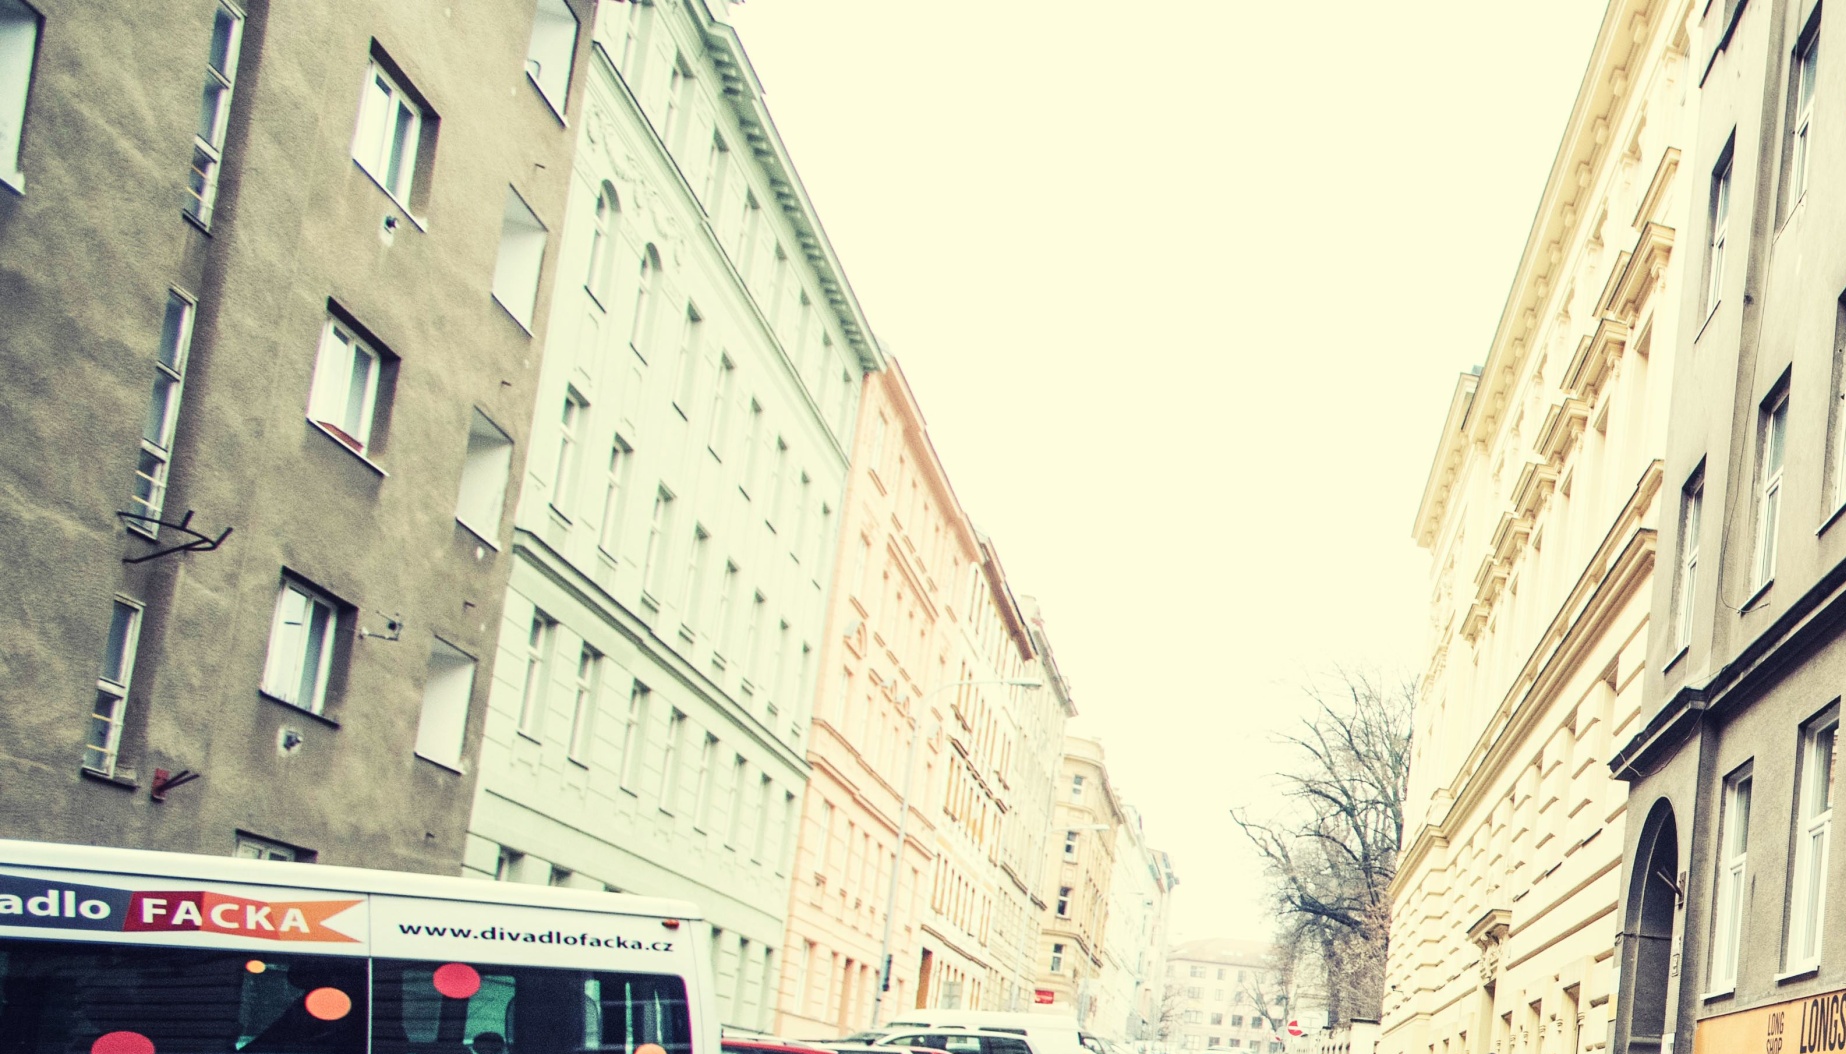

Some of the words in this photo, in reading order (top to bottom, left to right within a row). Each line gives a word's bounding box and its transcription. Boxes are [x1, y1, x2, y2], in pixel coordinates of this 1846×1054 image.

[141, 898, 310, 934] FACKA
[399, 923, 674, 952] www.divadlofacka.cz
[1767, 1011, 1785, 1036] LONG
